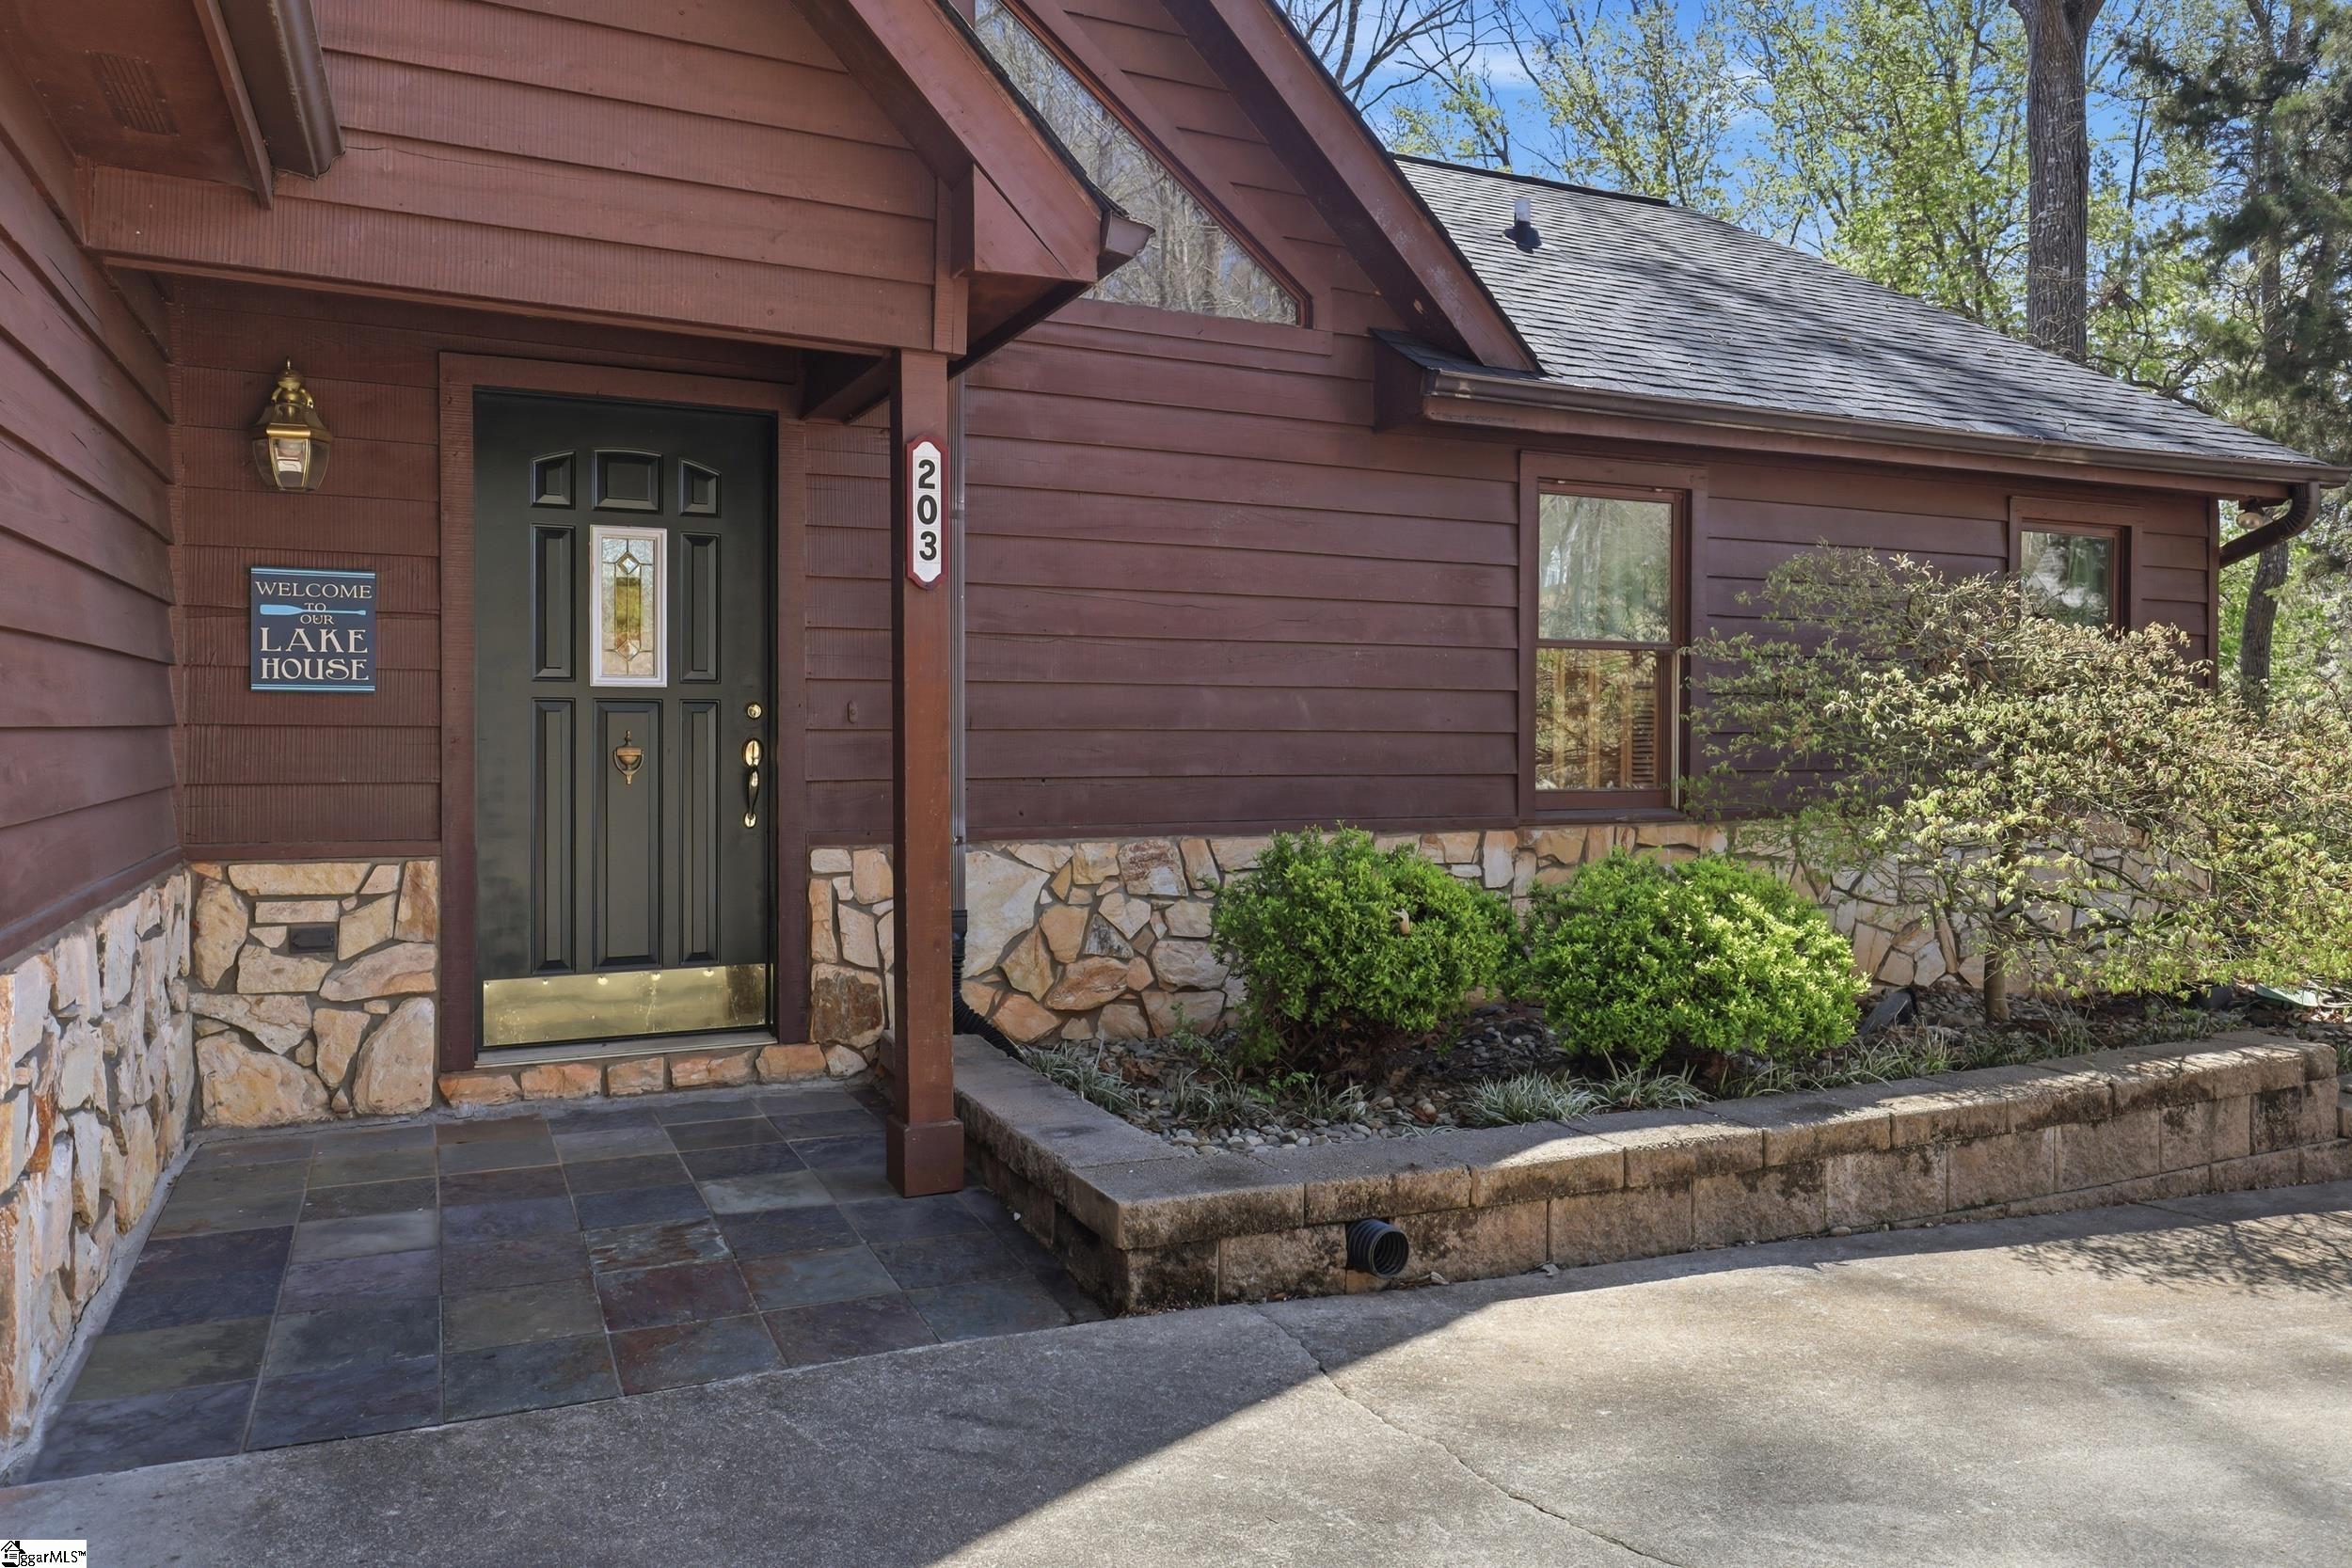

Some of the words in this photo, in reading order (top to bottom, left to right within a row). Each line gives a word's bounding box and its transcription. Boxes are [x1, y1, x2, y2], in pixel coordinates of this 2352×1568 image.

[917, 459, 937, 561] 203
[255, 581, 373, 599] WELCOME
[304, 602, 326, 612] TO
[300, 614, 334, 625] OUR
[260, 627, 368, 653] LAKE
[261, 657, 369, 680] HOUSE
